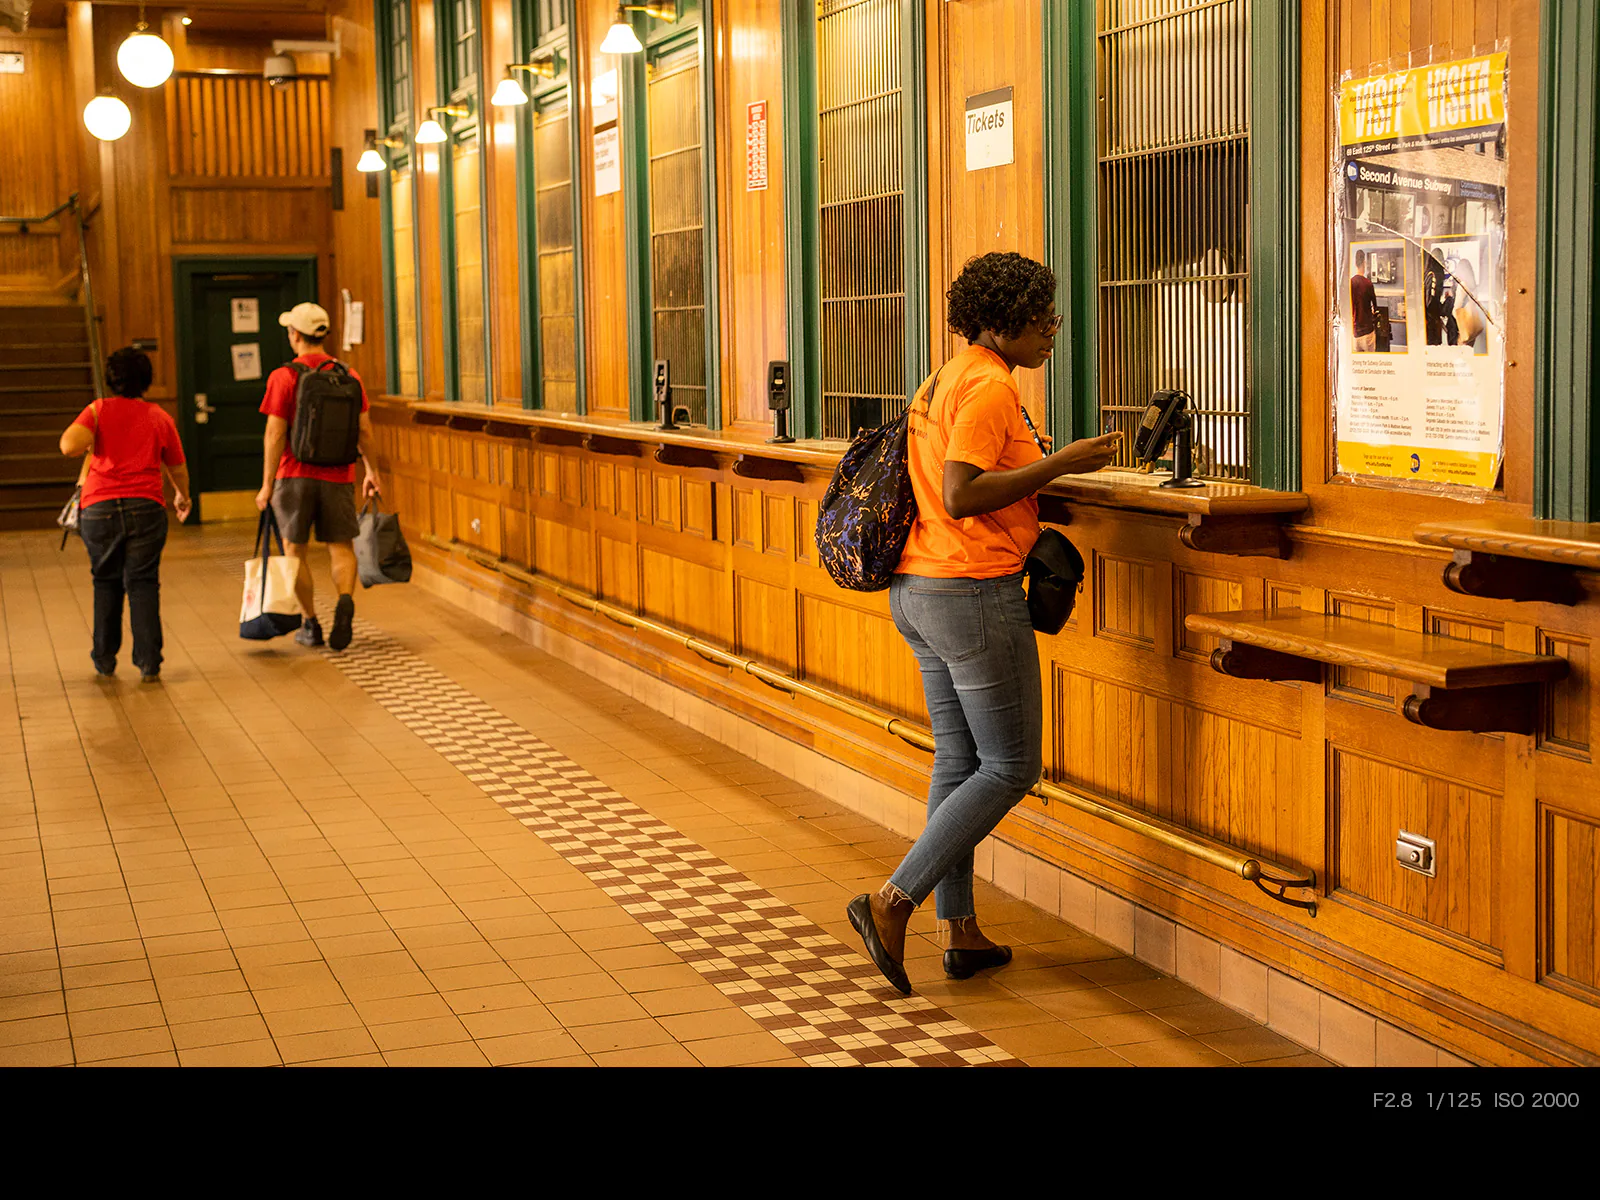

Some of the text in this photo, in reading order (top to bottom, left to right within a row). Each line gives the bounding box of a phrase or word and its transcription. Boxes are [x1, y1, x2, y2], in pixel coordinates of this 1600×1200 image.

[1355, 75, 1408, 138] VISIT
[1427, 60, 1493, 128] VISITA
[967, 109, 1005, 134] Tickets
[1352, 147, 1362, 155] East
[1375, 143, 1390, 152] Street
[1360, 166, 1390, 184] Second
[1391, 173, 1423, 189] Avenue
[1424, 178, 1452, 195] Subway
